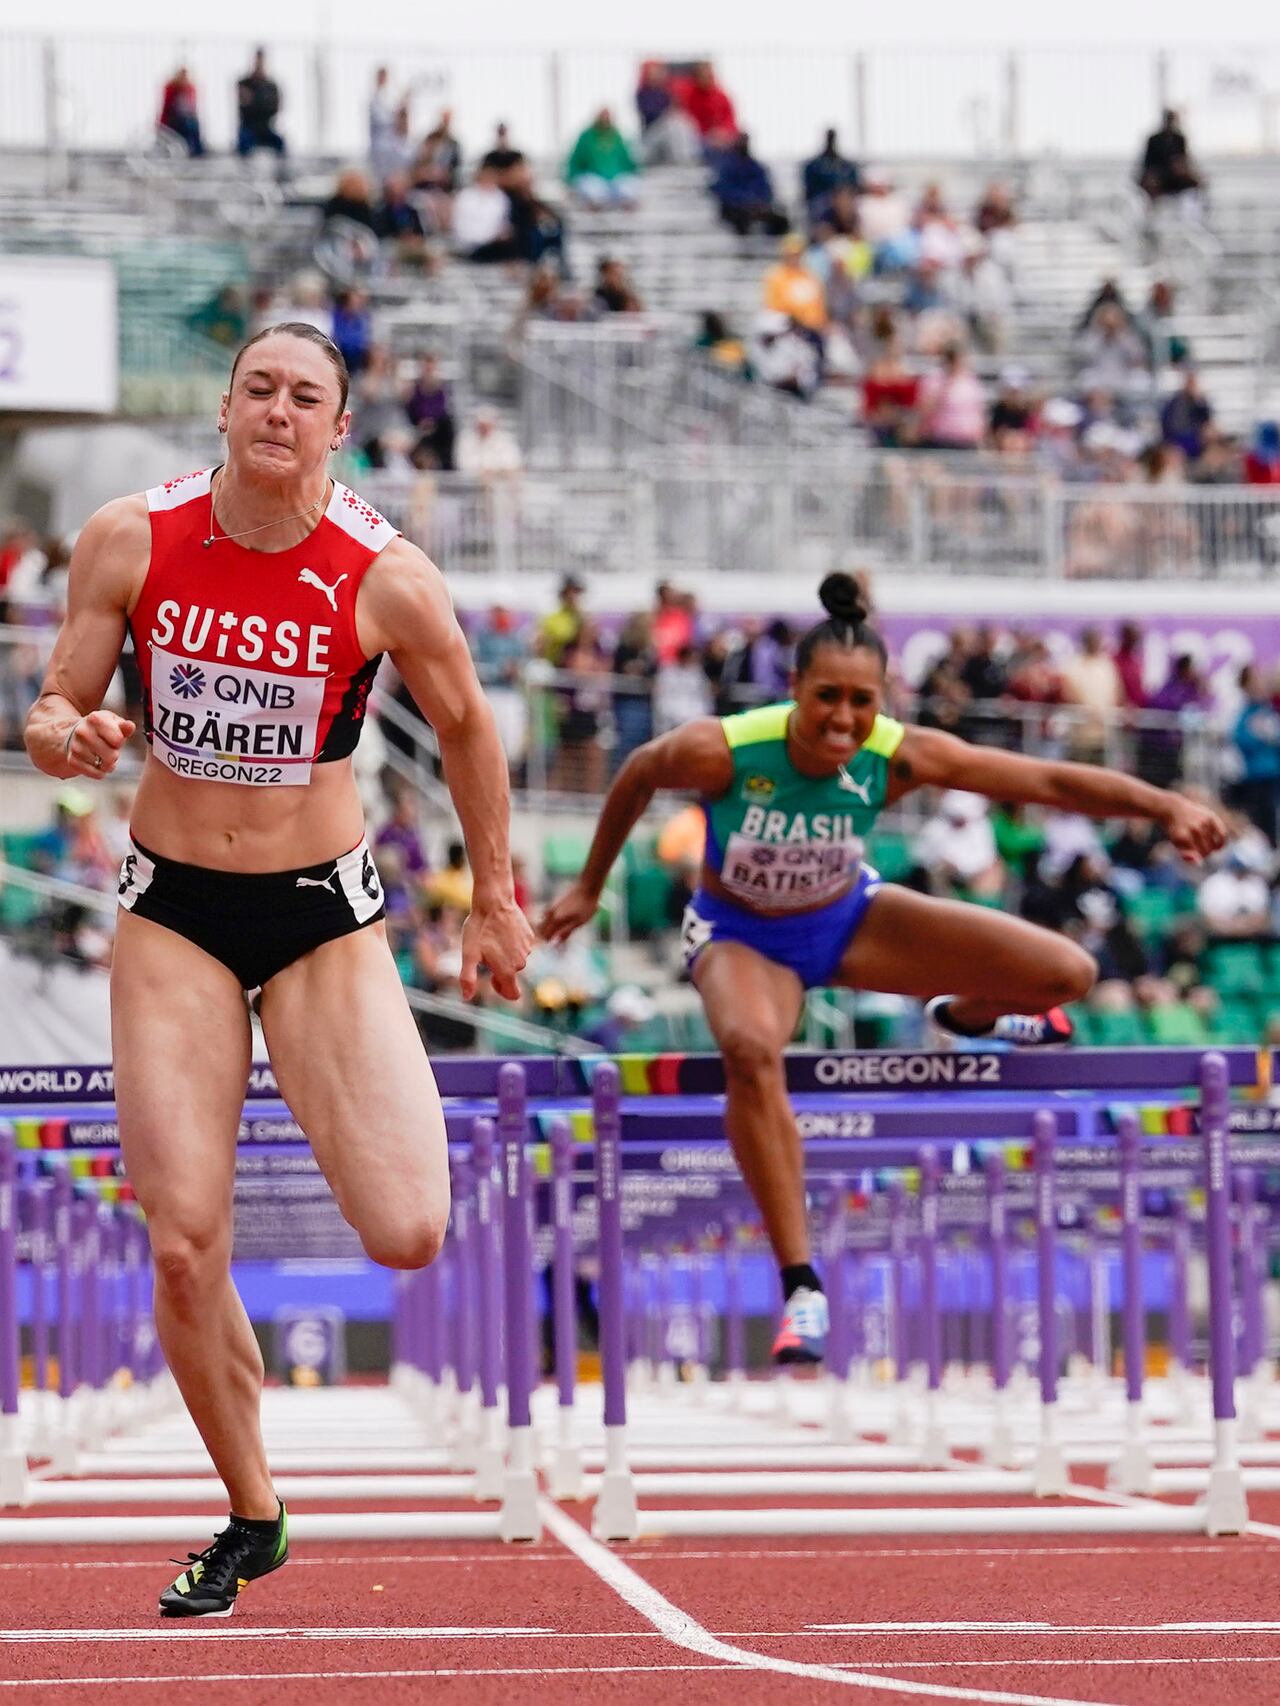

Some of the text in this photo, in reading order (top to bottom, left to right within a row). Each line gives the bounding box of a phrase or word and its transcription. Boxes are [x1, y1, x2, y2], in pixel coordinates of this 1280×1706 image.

[214, 674, 295, 709] QNB
[158, 703, 303, 755] ZBÄREN
[167, 752, 282, 783] OREGON22
[815, 1055, 1000, 1084] OREGON22
